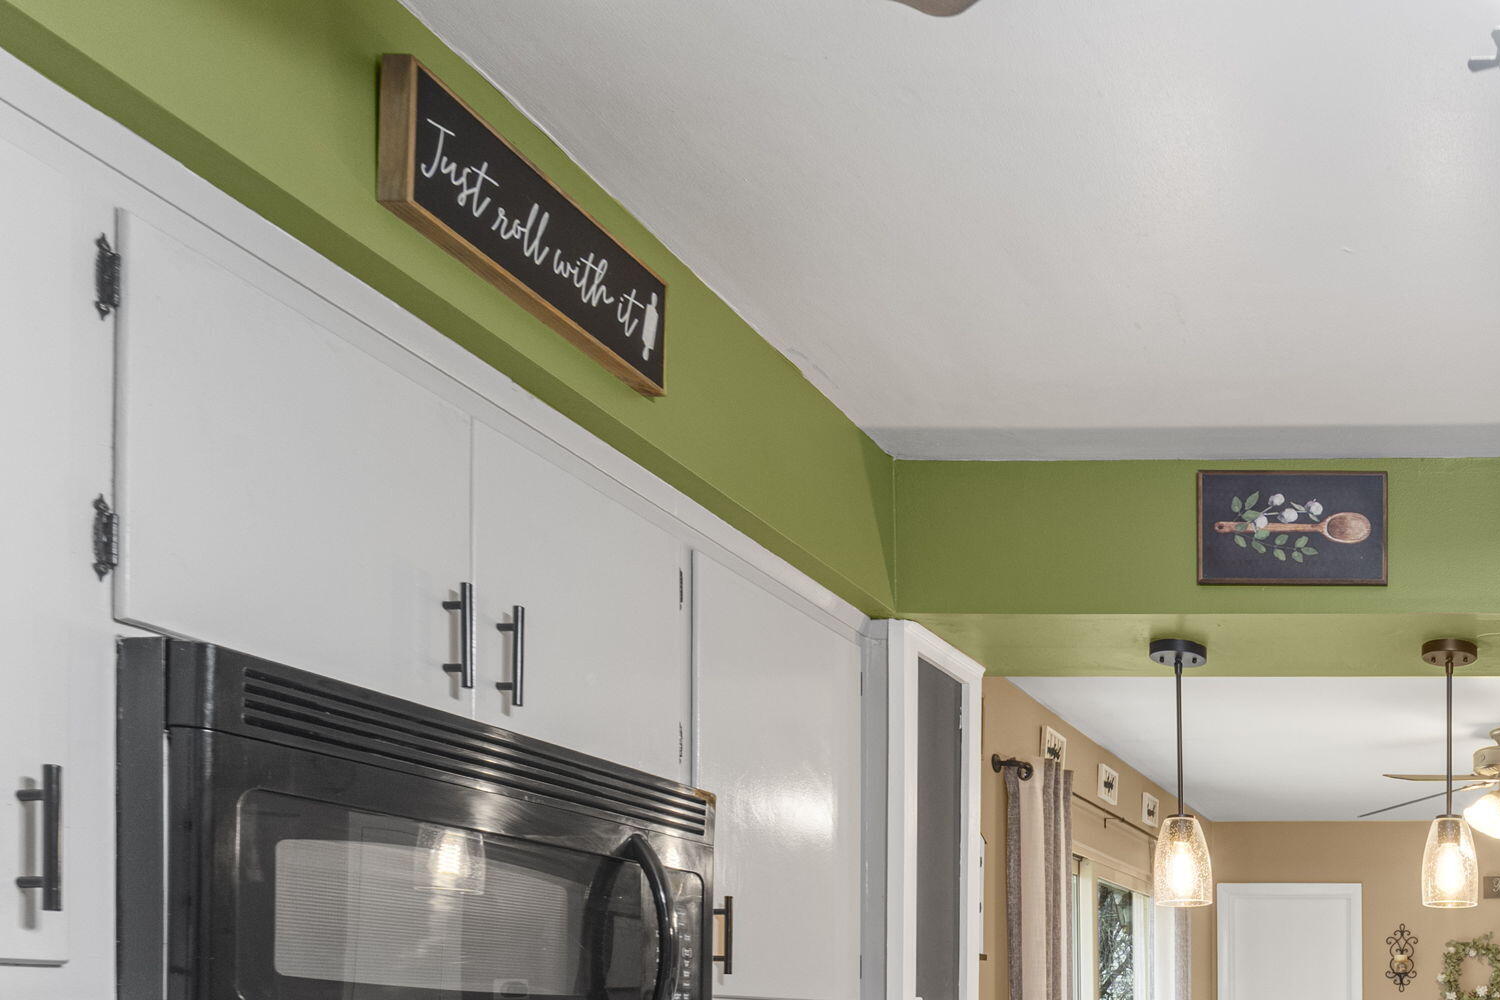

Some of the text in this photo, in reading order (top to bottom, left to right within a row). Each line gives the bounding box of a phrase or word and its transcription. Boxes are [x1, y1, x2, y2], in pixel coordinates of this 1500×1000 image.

[420, 117, 645, 338] Just roll with it
